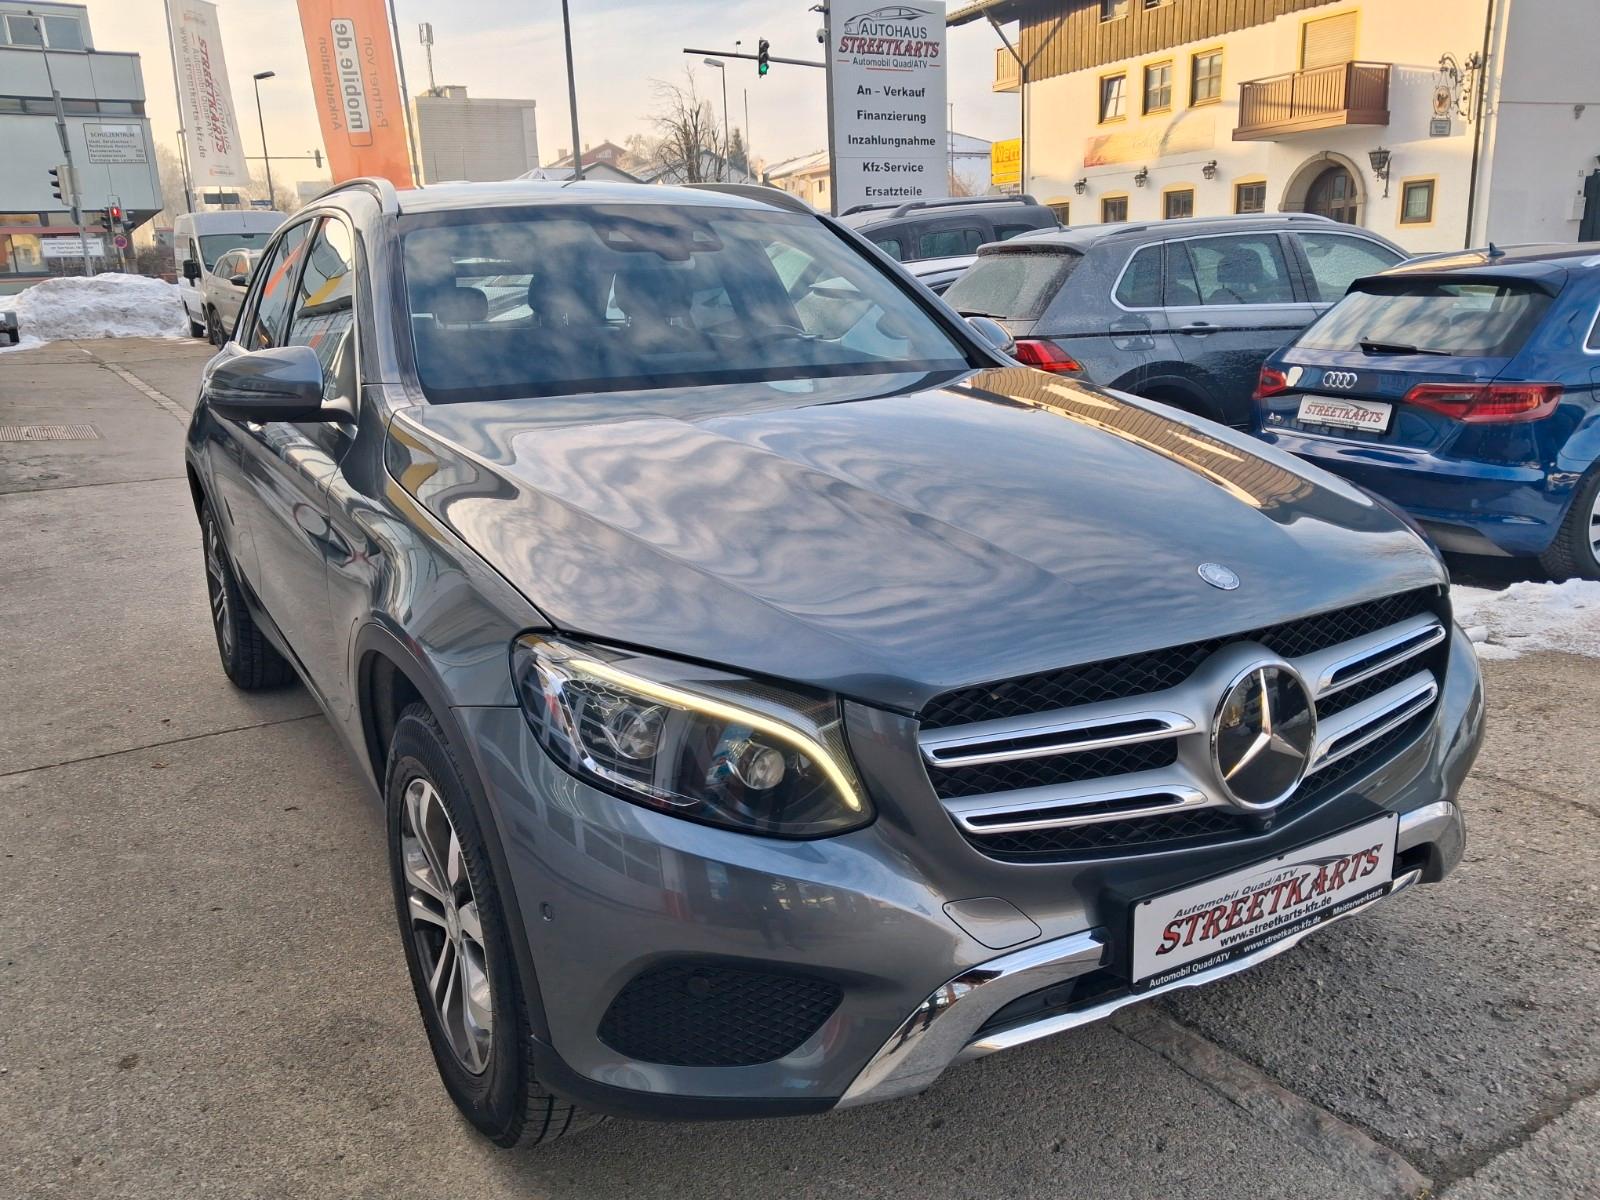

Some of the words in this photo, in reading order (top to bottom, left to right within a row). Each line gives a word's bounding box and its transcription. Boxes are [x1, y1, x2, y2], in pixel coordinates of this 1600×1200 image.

[860, 23, 927, 39] AUTOHAUS
[838, 36, 940, 59] STREETKARTS
[852, 56, 891, 67] Automobil
[892, 58, 928, 69] Quad/ATV
[198, 37, 227, 155] STREETKARTS
[857, 85, 872, 96] An
[883, 86, 926, 97] Verkauf
[856, 110, 927, 124] Finanzierung
[848, 134, 936, 147] Inzahlungnahme
[862, 161, 924, 173] Kfz-Service
[865, 186, 923, 197] Ersatzteile
[1305, 404, 1384, 423] STREETKARTS
[1156, 843, 1383, 956] STREETKARTS
[1174, 889, 1239, 918] Automobil
[1242, 867, 1299, 894] Quad/ATV
[1220, 895, 1332, 947] www.streetkarts-kfz.de
[1149, 965, 1191, 988] Automobil
[1192, 951, 1231, 974] Quad/ATV
[1243, 915, 1322, 953] www.streetkarts-kfz.de
[1332, 888, 1384, 916] Meisterwerkstatt
